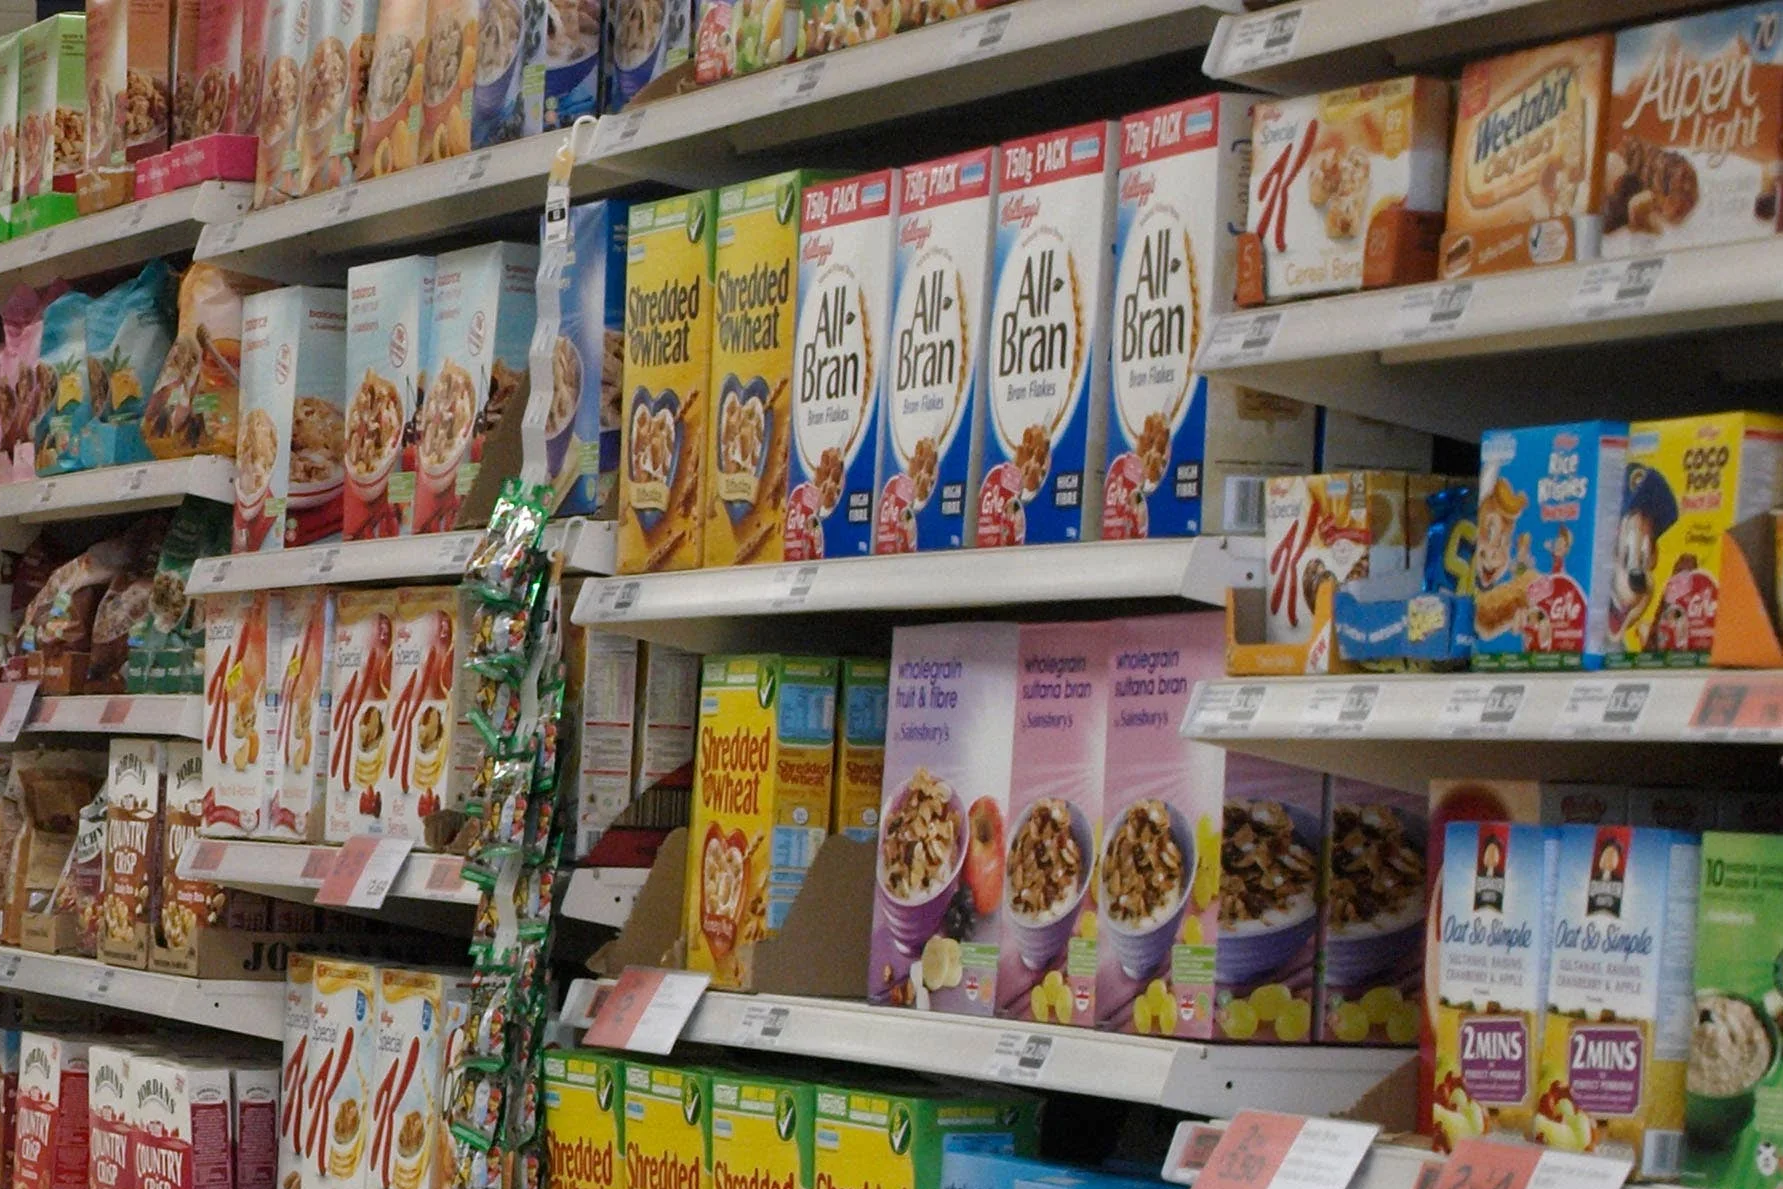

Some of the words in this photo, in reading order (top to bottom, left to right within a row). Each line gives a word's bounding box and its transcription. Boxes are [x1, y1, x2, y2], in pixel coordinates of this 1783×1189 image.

[1621, 48, 1760, 143] Alpen
[1474, 67, 1574, 167] Weetabix
[1690, 105, 1764, 169] Light
[904, 170, 927, 206] 750g
[930, 163, 958, 195] PACK
[805, 191, 828, 225] 750g
[830, 182, 859, 216] PACK
[628, 273, 701, 327] Shredded
[717, 256, 791, 316] Shredded
[1121, 293, 1184, 363] Bran
[998, 310, 1067, 378] Bran
[800, 342, 858, 404] Bran
[896, 329, 955, 392] Bran
[920, 394, 944, 412] Flakes
[1029, 379, 1056, 399] Flakes
[807, 409, 823, 427] Bran
[824, 406, 849, 424] Flakes
[1548, 451, 1580, 476] Rice
[1682, 446, 1730, 471] COCO
[942, 484, 963, 500] HIGH
[1686, 472, 1722, 492] POPS
[849, 492, 870, 507] HIGH
[941, 499, 963, 515] FIBRE
[848, 507, 870, 523] FIBRE
[897, 656, 963, 687] wholegrain
[1024, 656, 1087, 680] wholegrain
[1116, 649, 1180, 674] wholegrain
[895, 687, 916, 709] fruit
[929, 686, 958, 709] fibre
[1022, 680, 1060, 700] sultana
[1064, 679, 1092, 699] bran
[1114, 677, 1154, 698] sultana
[1157, 675, 1188, 696] bran
[700, 725, 771, 778] Shredded
[109, 820, 149, 857] COUNTRY
[114, 851, 138, 875] CRISP
[1443, 915, 1470, 943] Oat
[1471, 916, 1486, 941] So
[1487, 919, 1533, 953] Simple
[1554, 920, 1581, 949] Oat
[1582, 922, 1600, 949] So
[1602, 925, 1654, 961] Simple
[1499, 972, 1523, 987] APPLE
[18, 1106, 52, 1147] COUNTRY
[21, 1137, 42, 1163] CRISP
[91, 1127, 128, 1170] COUNTRY
[96, 1159, 118, 1186] CRISP
[136, 1142, 183, 1188] COUNTRY
